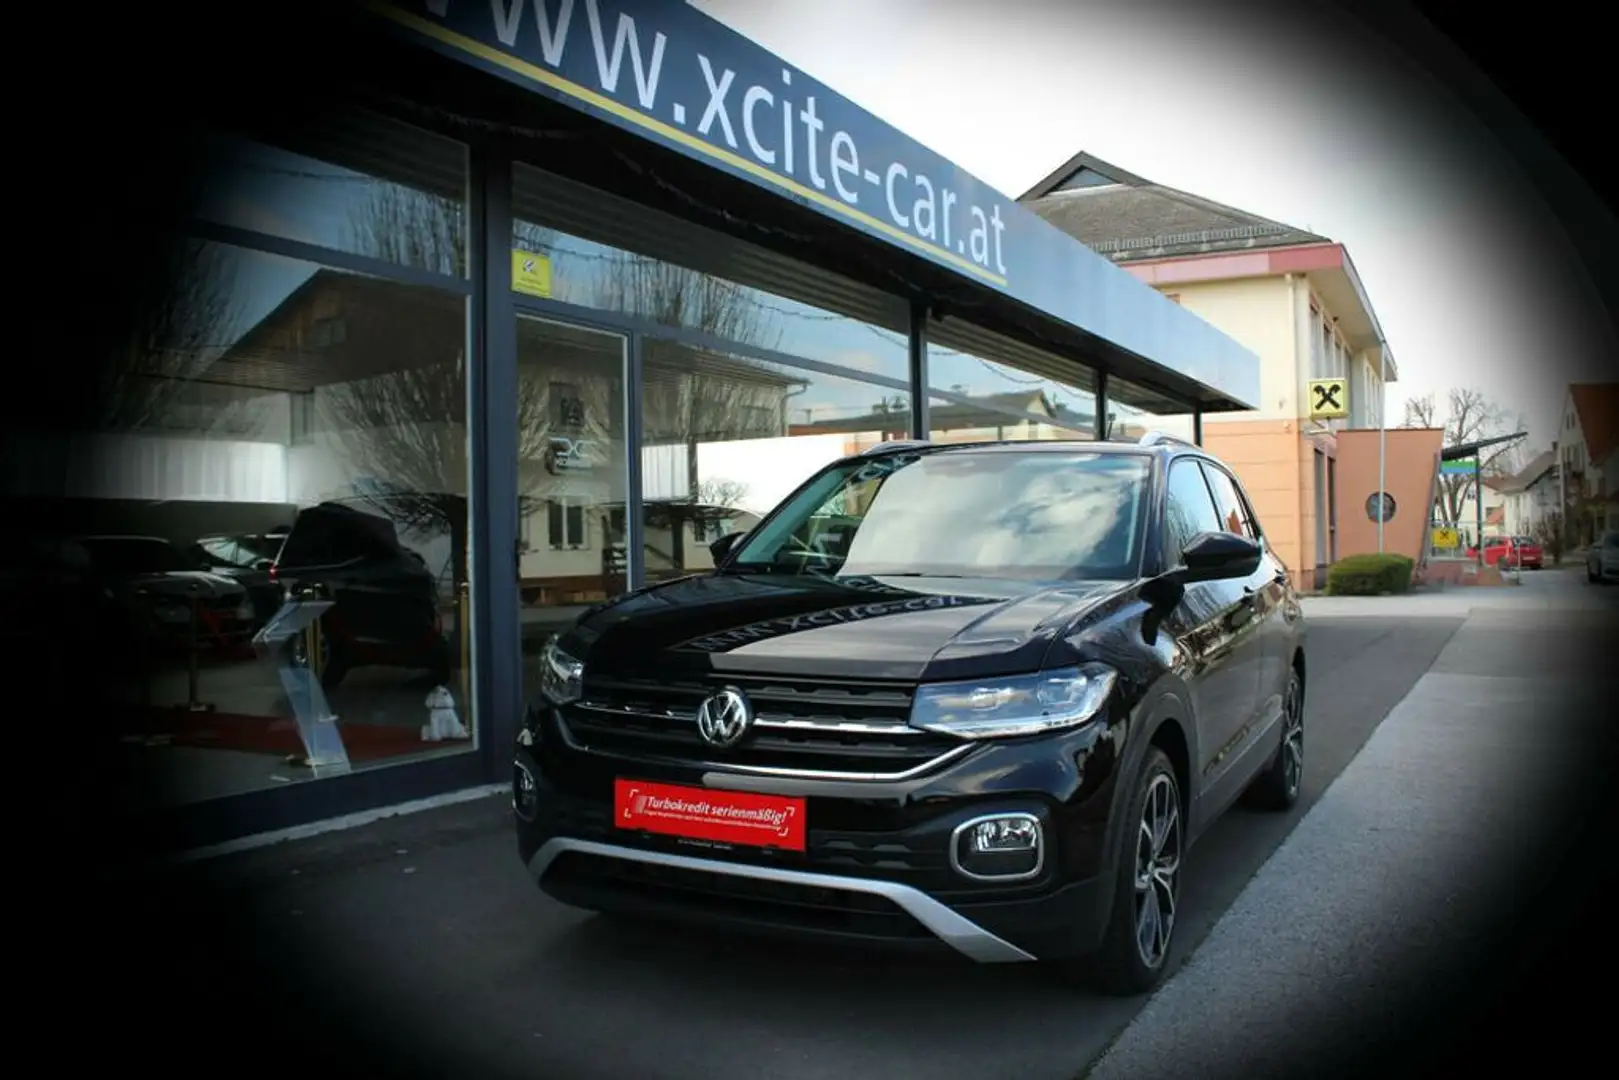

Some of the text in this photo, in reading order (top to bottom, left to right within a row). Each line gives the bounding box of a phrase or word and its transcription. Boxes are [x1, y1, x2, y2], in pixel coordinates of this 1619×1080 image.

[425, 0, 1007, 276] ww.xcite-car.at
[647, 795, 711, 815] Turbokredit
[711, 803, 787, 825] serienmäßig!
